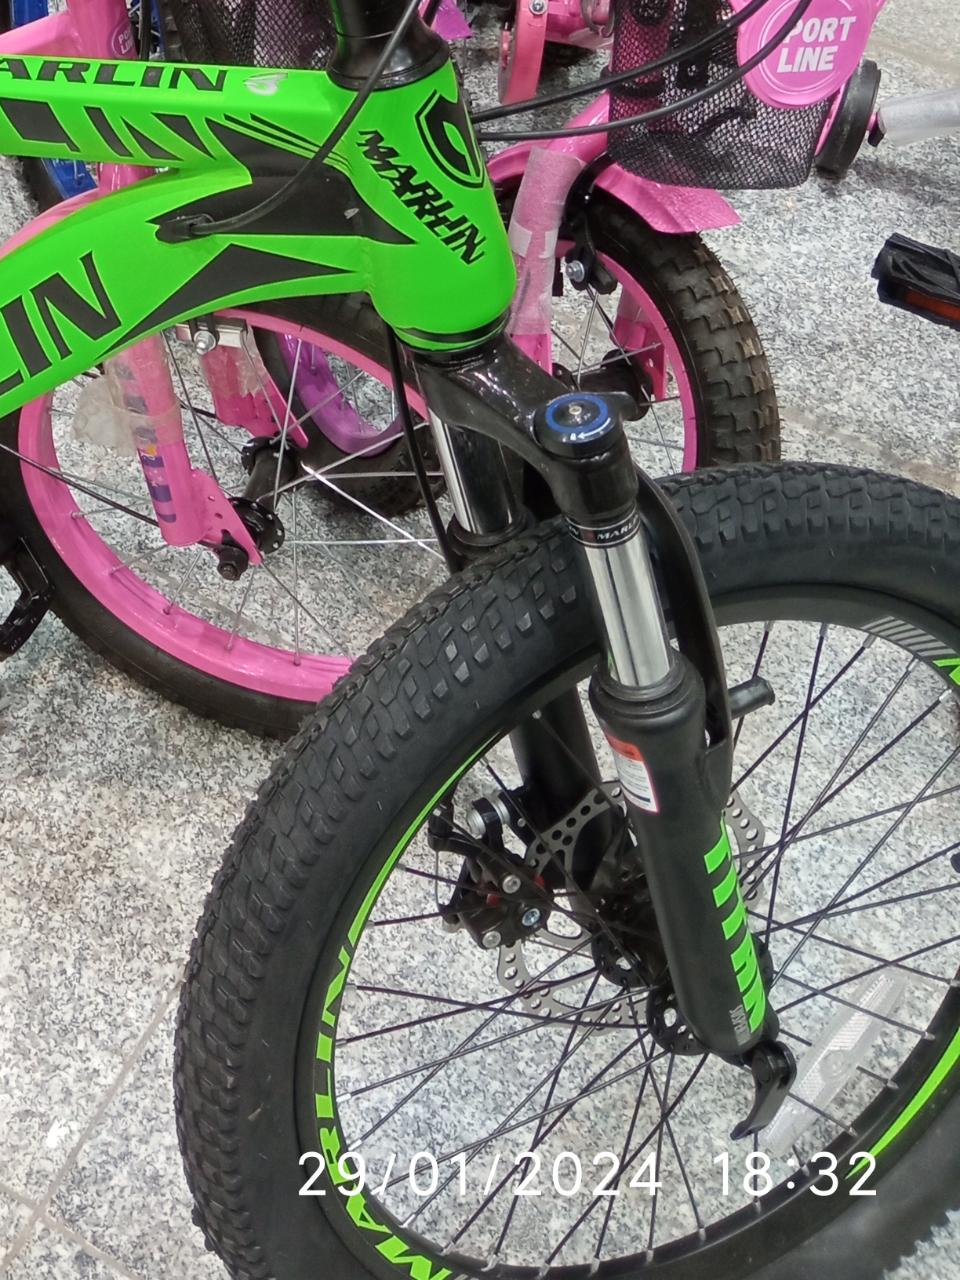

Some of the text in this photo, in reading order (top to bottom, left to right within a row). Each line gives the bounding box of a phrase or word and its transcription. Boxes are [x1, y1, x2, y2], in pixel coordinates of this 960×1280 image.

[785, 16, 856, 44] PORT
[776, 46, 838, 74] LINE
[356, 129, 487, 265] MARLIN
